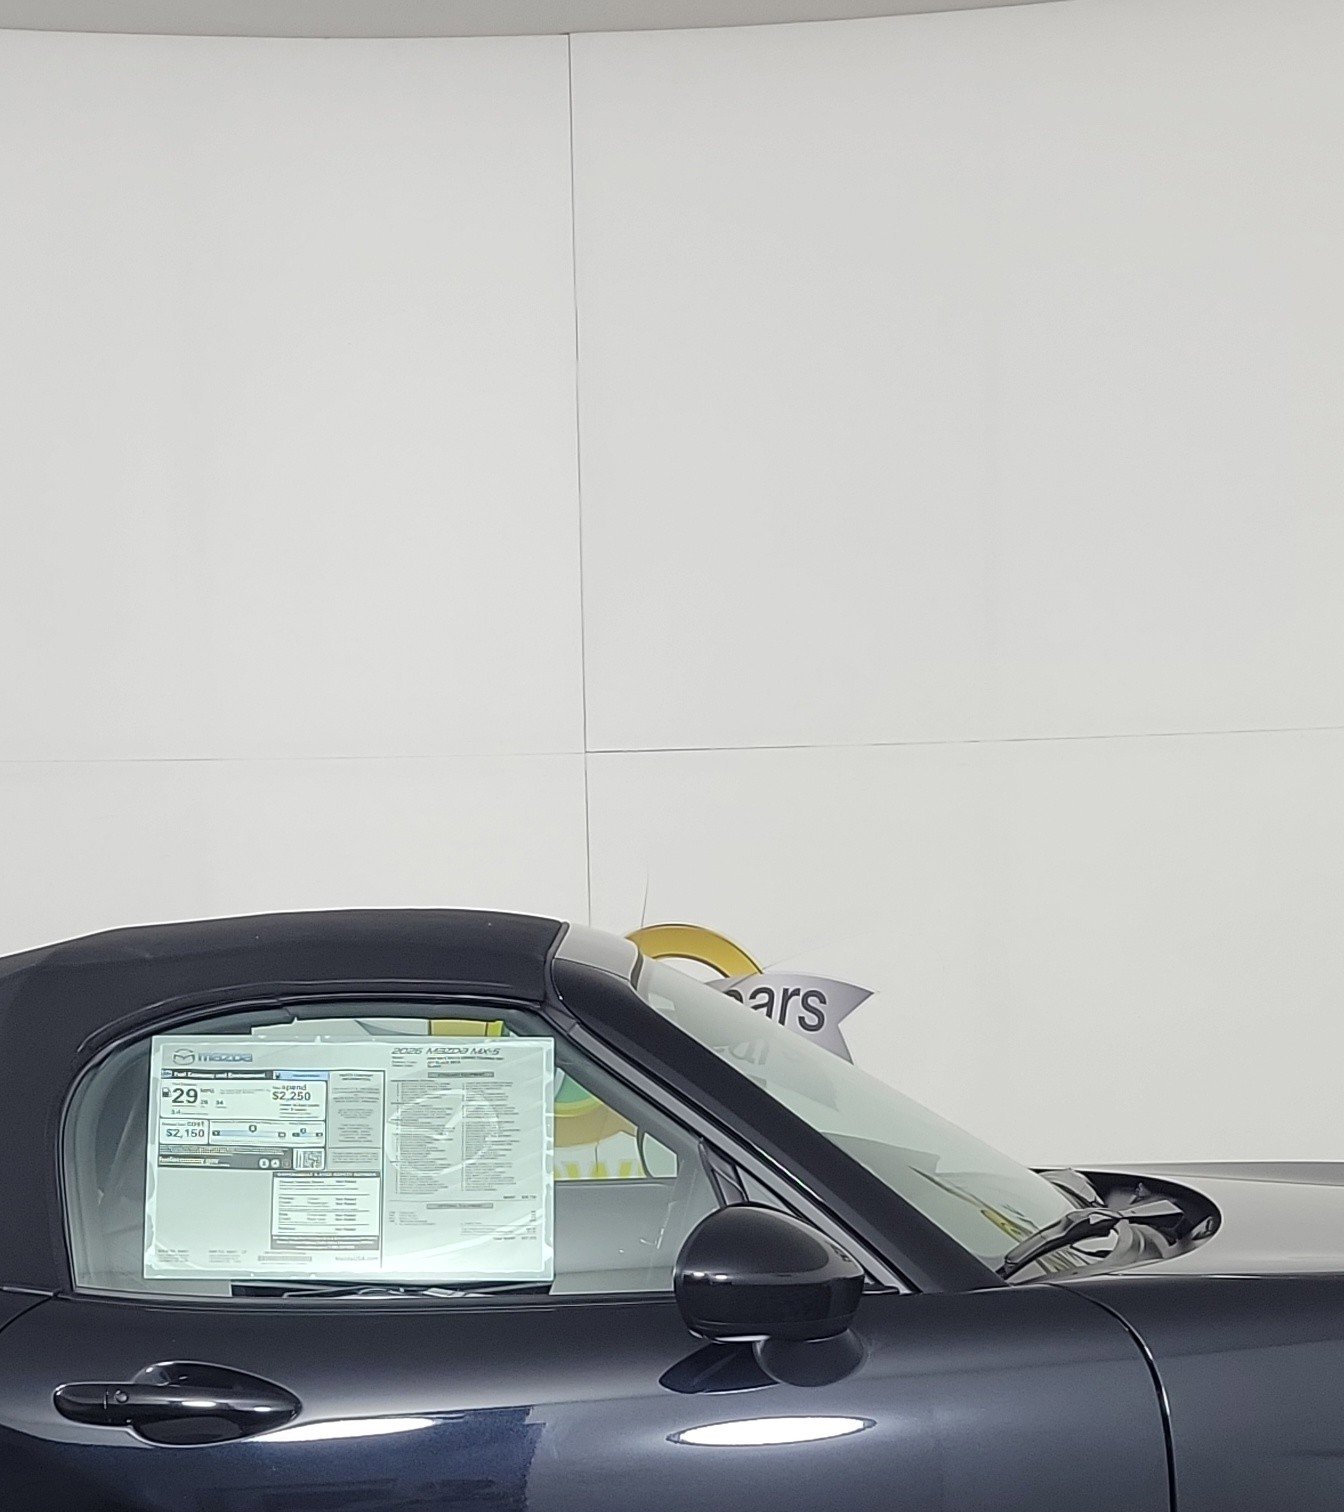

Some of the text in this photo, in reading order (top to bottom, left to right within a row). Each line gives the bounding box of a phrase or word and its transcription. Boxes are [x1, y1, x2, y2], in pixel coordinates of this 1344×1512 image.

[171, 1087, 198, 1104] 29
[272, 1091, 311, 1101] $2,250
[166, 1128, 205, 1139] $2,150
